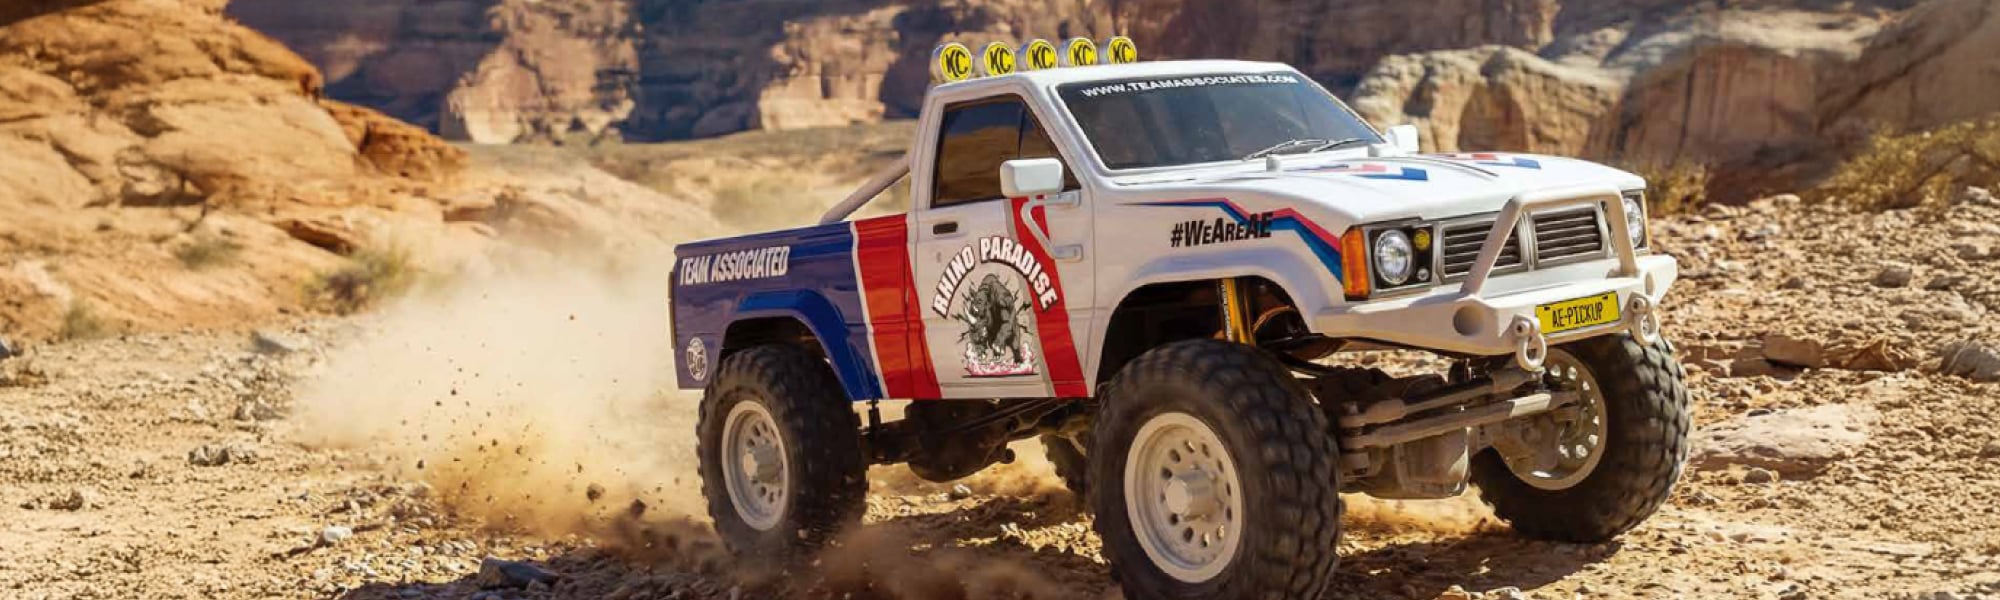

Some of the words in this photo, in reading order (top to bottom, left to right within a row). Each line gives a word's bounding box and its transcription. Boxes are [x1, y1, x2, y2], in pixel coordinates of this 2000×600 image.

[945, 49, 969, 78] KC
[990, 47, 1013, 74] KC
[1031, 45, 1055, 69] KC
[1073, 44, 1094, 66] KC
[1112, 42, 1133, 64] KC
[680, 255, 711, 286] TEAM
[711, 245, 790, 282] ASSOCIATED
[932, 245, 976, 319] RHINO
[979, 235, 1059, 311] PARADISE
[1552, 302, 1603, 328] AE-PICKUP
